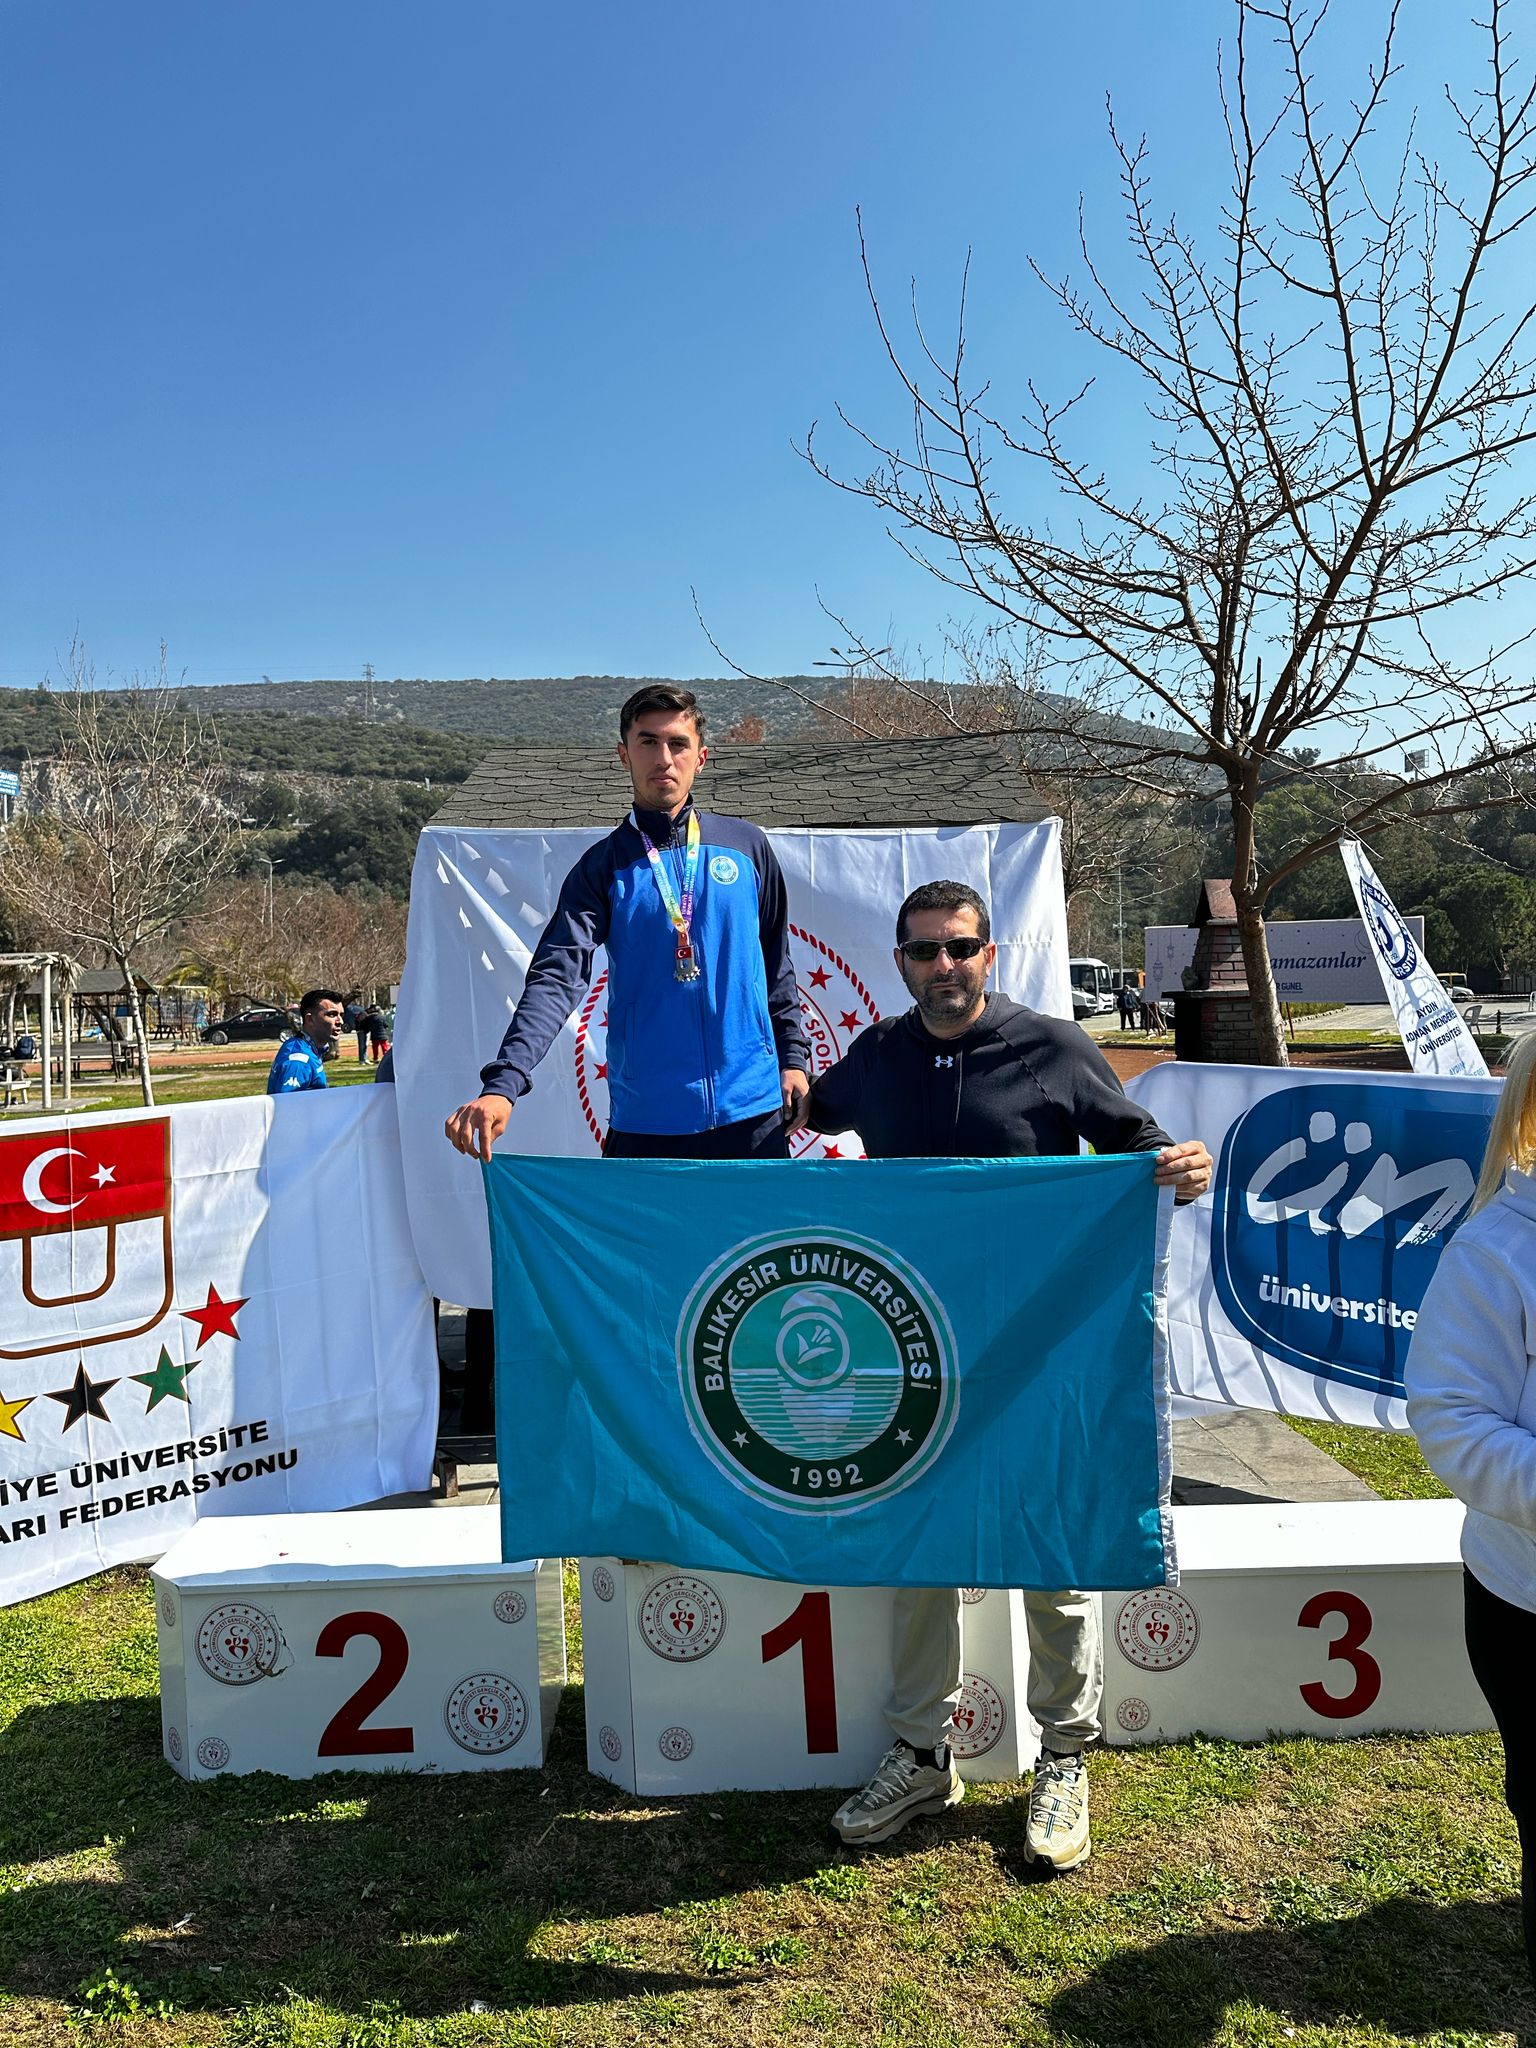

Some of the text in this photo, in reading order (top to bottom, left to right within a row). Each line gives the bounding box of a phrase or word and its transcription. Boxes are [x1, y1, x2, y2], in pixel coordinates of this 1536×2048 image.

[1270, 951, 1367, 970] amazanlar
[1405, 1024, 1431, 1043] ADNAN
[1416, 1001, 1439, 1019] AYDIN
[704, 1248, 937, 1392] BALIKESİR ÜNİVERSİTESİ
[1259, 1274, 1419, 1332] üniversite
[59, 1448, 298, 1530] FEDERASYONU
[70, 1420, 269, 1489] ÜNİVERSİTE
[789, 1463, 863, 1489] 1992
[314, 1610, 415, 1757] 2
[761, 1591, 839, 1755] 1
[1297, 1590, 1382, 1720] 3
